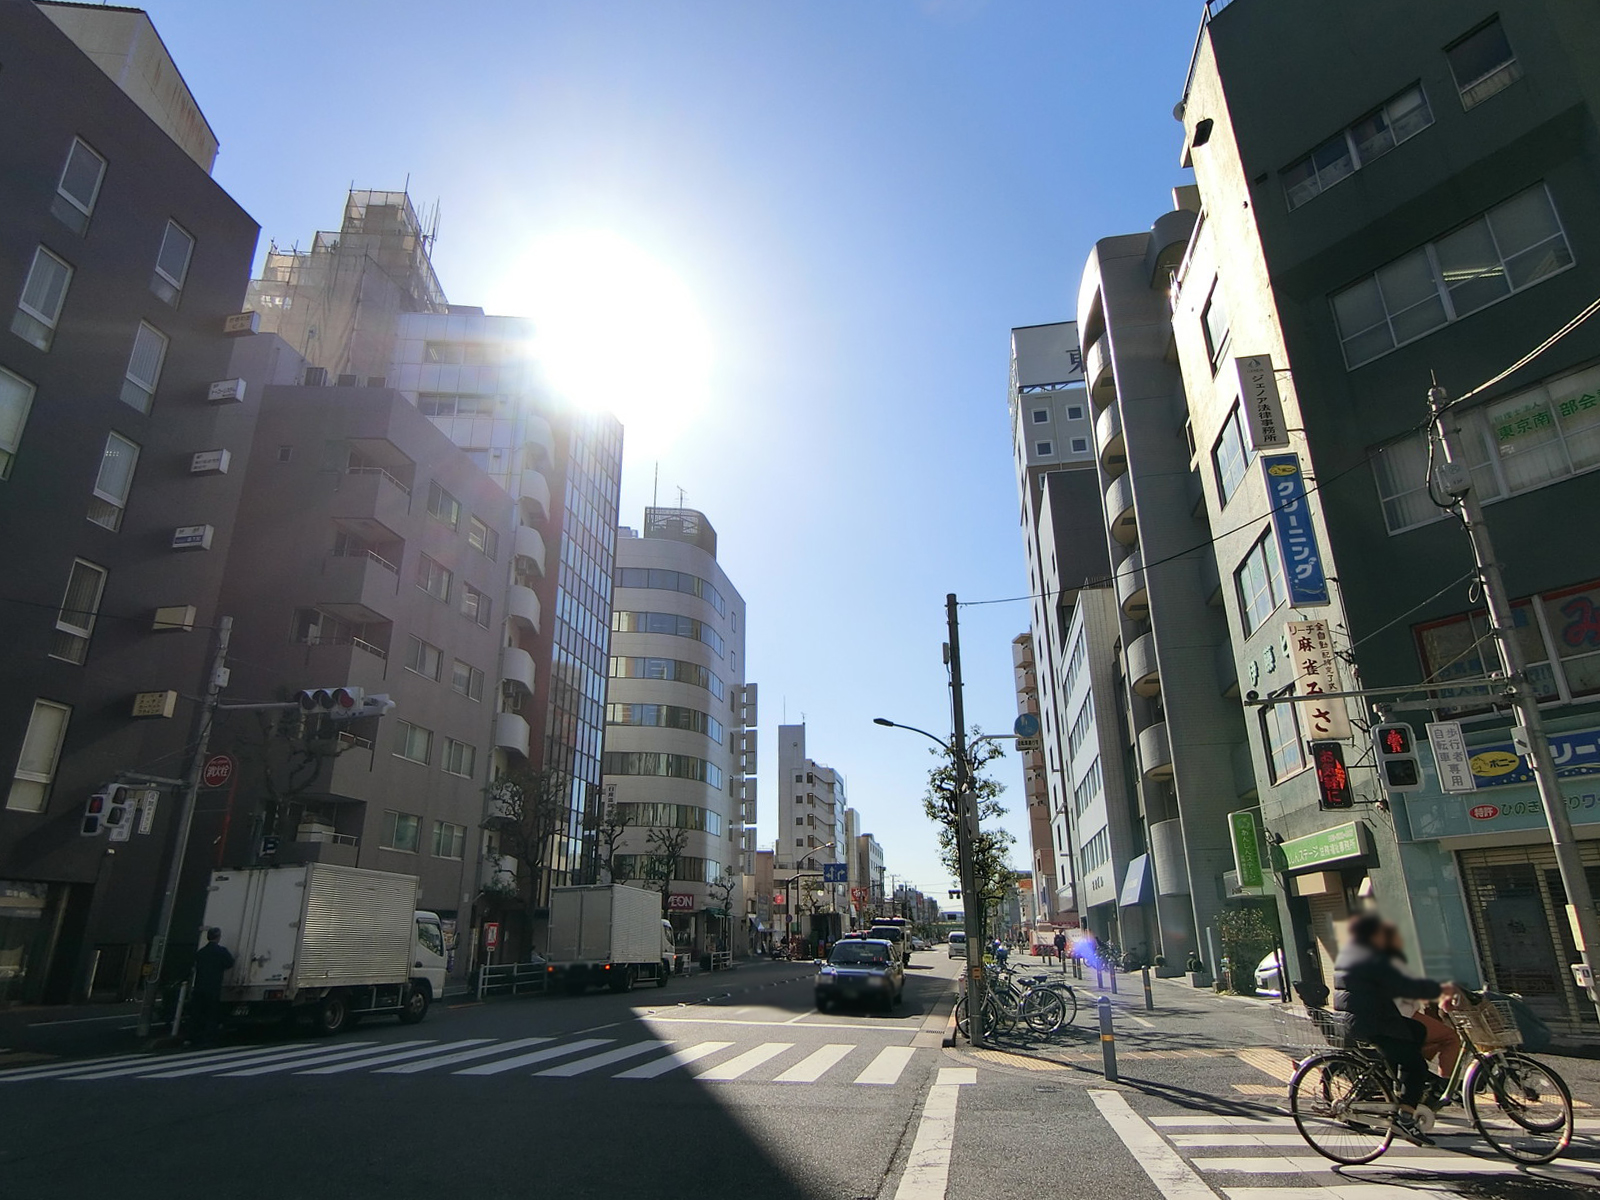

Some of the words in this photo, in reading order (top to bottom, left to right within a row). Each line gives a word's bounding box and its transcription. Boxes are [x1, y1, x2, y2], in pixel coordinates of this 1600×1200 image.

[1252, 374, 1276, 442] ジェノア法律事務所
[1497, 389, 1600, 440] 東京南部会
[1277, 481, 1317, 579] クリーニング
[1289, 625, 1315, 636] リーチ
[1297, 636, 1331, 733] 麻雀みさ
[1434, 729, 1451, 762] 自転車
[1446, 728, 1464, 787] 歩行者専用
[1549, 738, 1600, 765] リー
[1474, 807, 1494, 818] 特許
